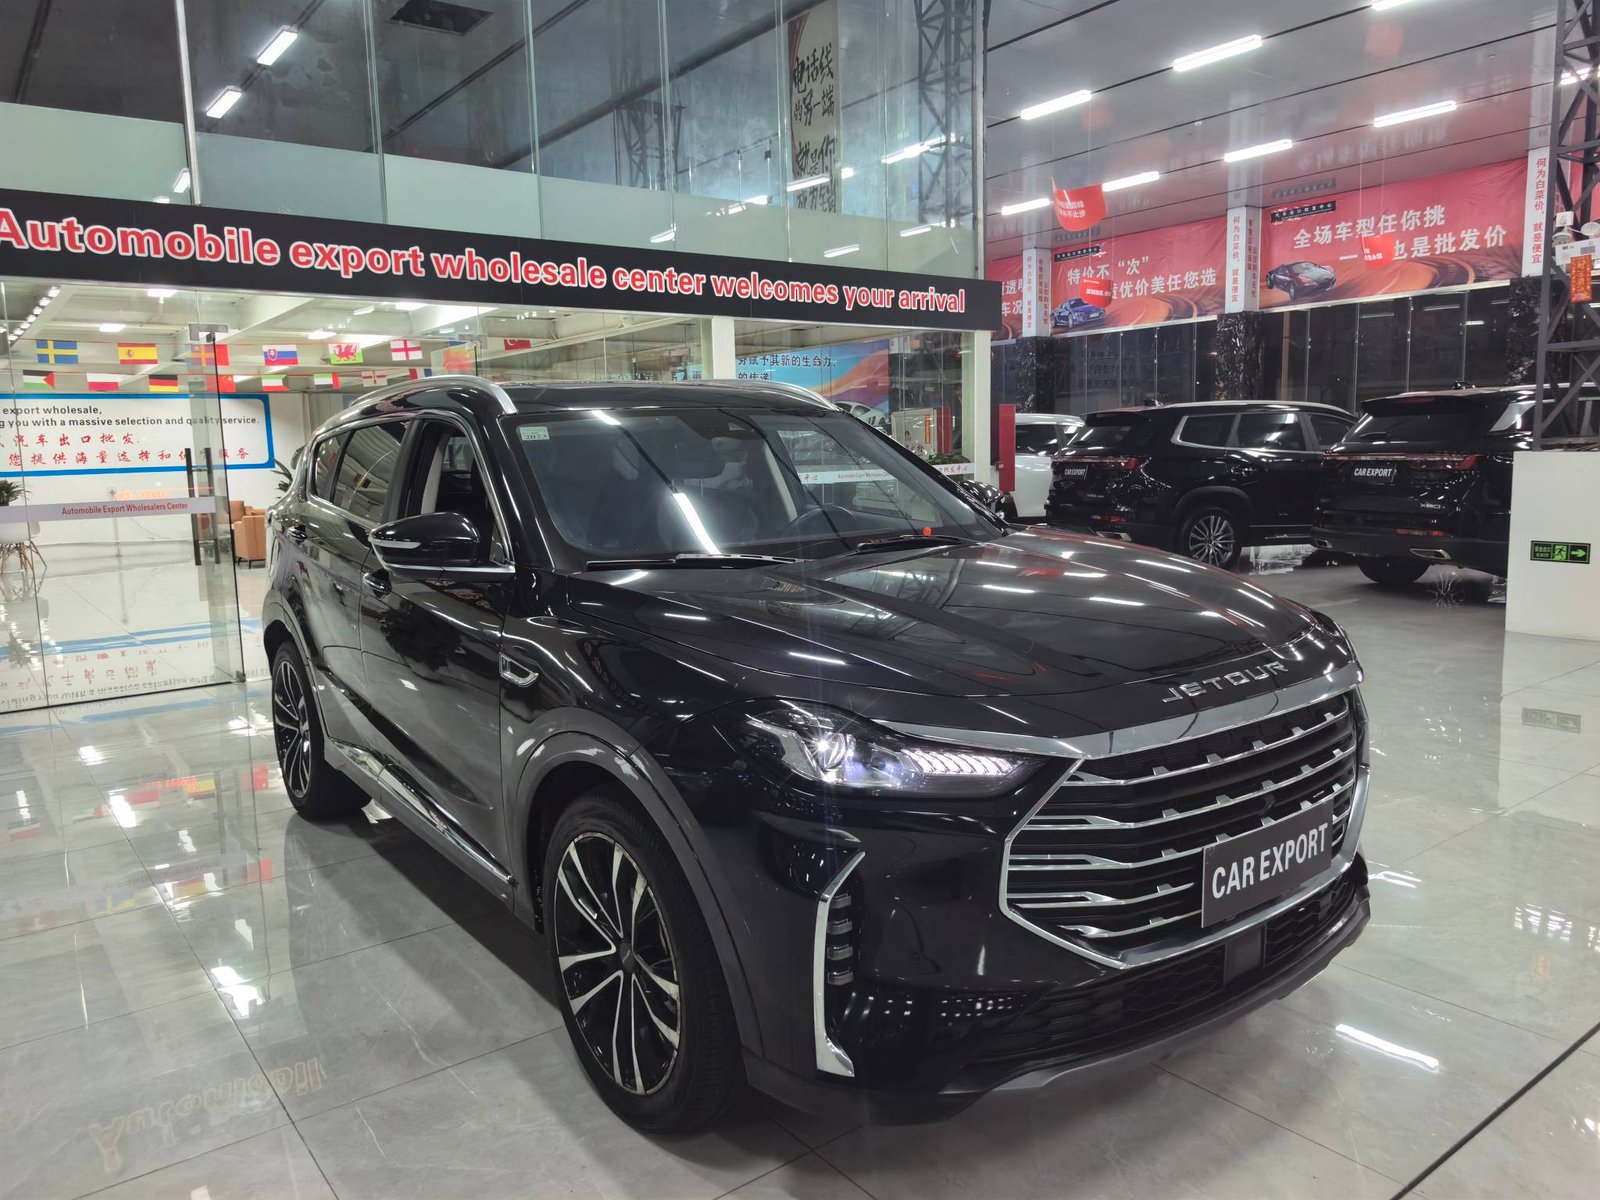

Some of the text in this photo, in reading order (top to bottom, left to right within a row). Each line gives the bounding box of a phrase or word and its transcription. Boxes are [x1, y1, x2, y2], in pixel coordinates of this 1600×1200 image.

[1293, 204, 1446, 249] 全场车型任你挑
[1339, 224, 1508, 262] 一也是批发价
[0, 207, 966, 314] Automobile export wholesale center welcomes your arrival
[3, 405, 102, 417] export wholesale,
[8, 420, 29, 428] you
[32, 418, 57, 426] with
[68, 417, 113, 426] massive
[115, 416, 162, 425] selection
[165, 416, 183, 425] and
[186, 416, 219, 426] quality
[222, 416, 260, 425] service.
[1354, 468, 1393, 477] CAR EXPORT
[61, 506, 102, 516] Automobile
[102, 505, 125, 514] Export
[167, 502, 189, 510] Center
[1161, 660, 1289, 703] JETOUR
[1211, 822, 1329, 899] CAR EXPORT
